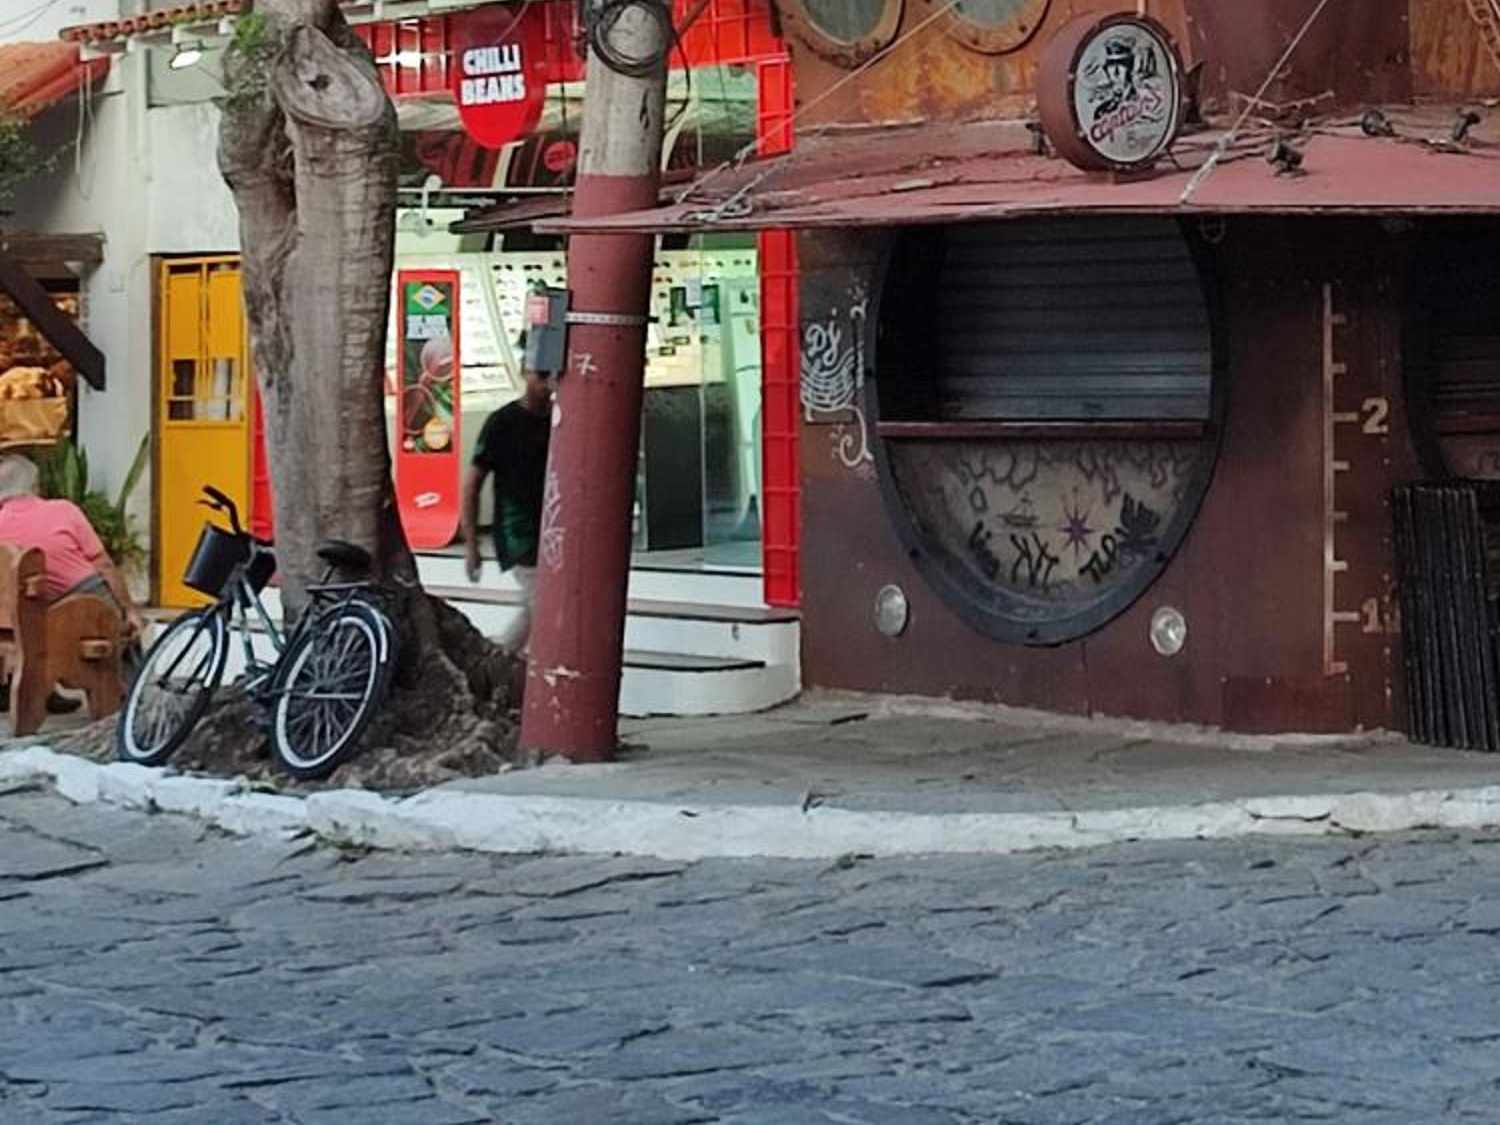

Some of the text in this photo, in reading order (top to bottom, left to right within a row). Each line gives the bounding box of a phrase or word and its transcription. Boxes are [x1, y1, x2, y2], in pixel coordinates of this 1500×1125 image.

[463, 45, 521, 76] CHILLI
[461, 74, 526, 106] BEANS
[1362, 397, 1389, 434] 2
